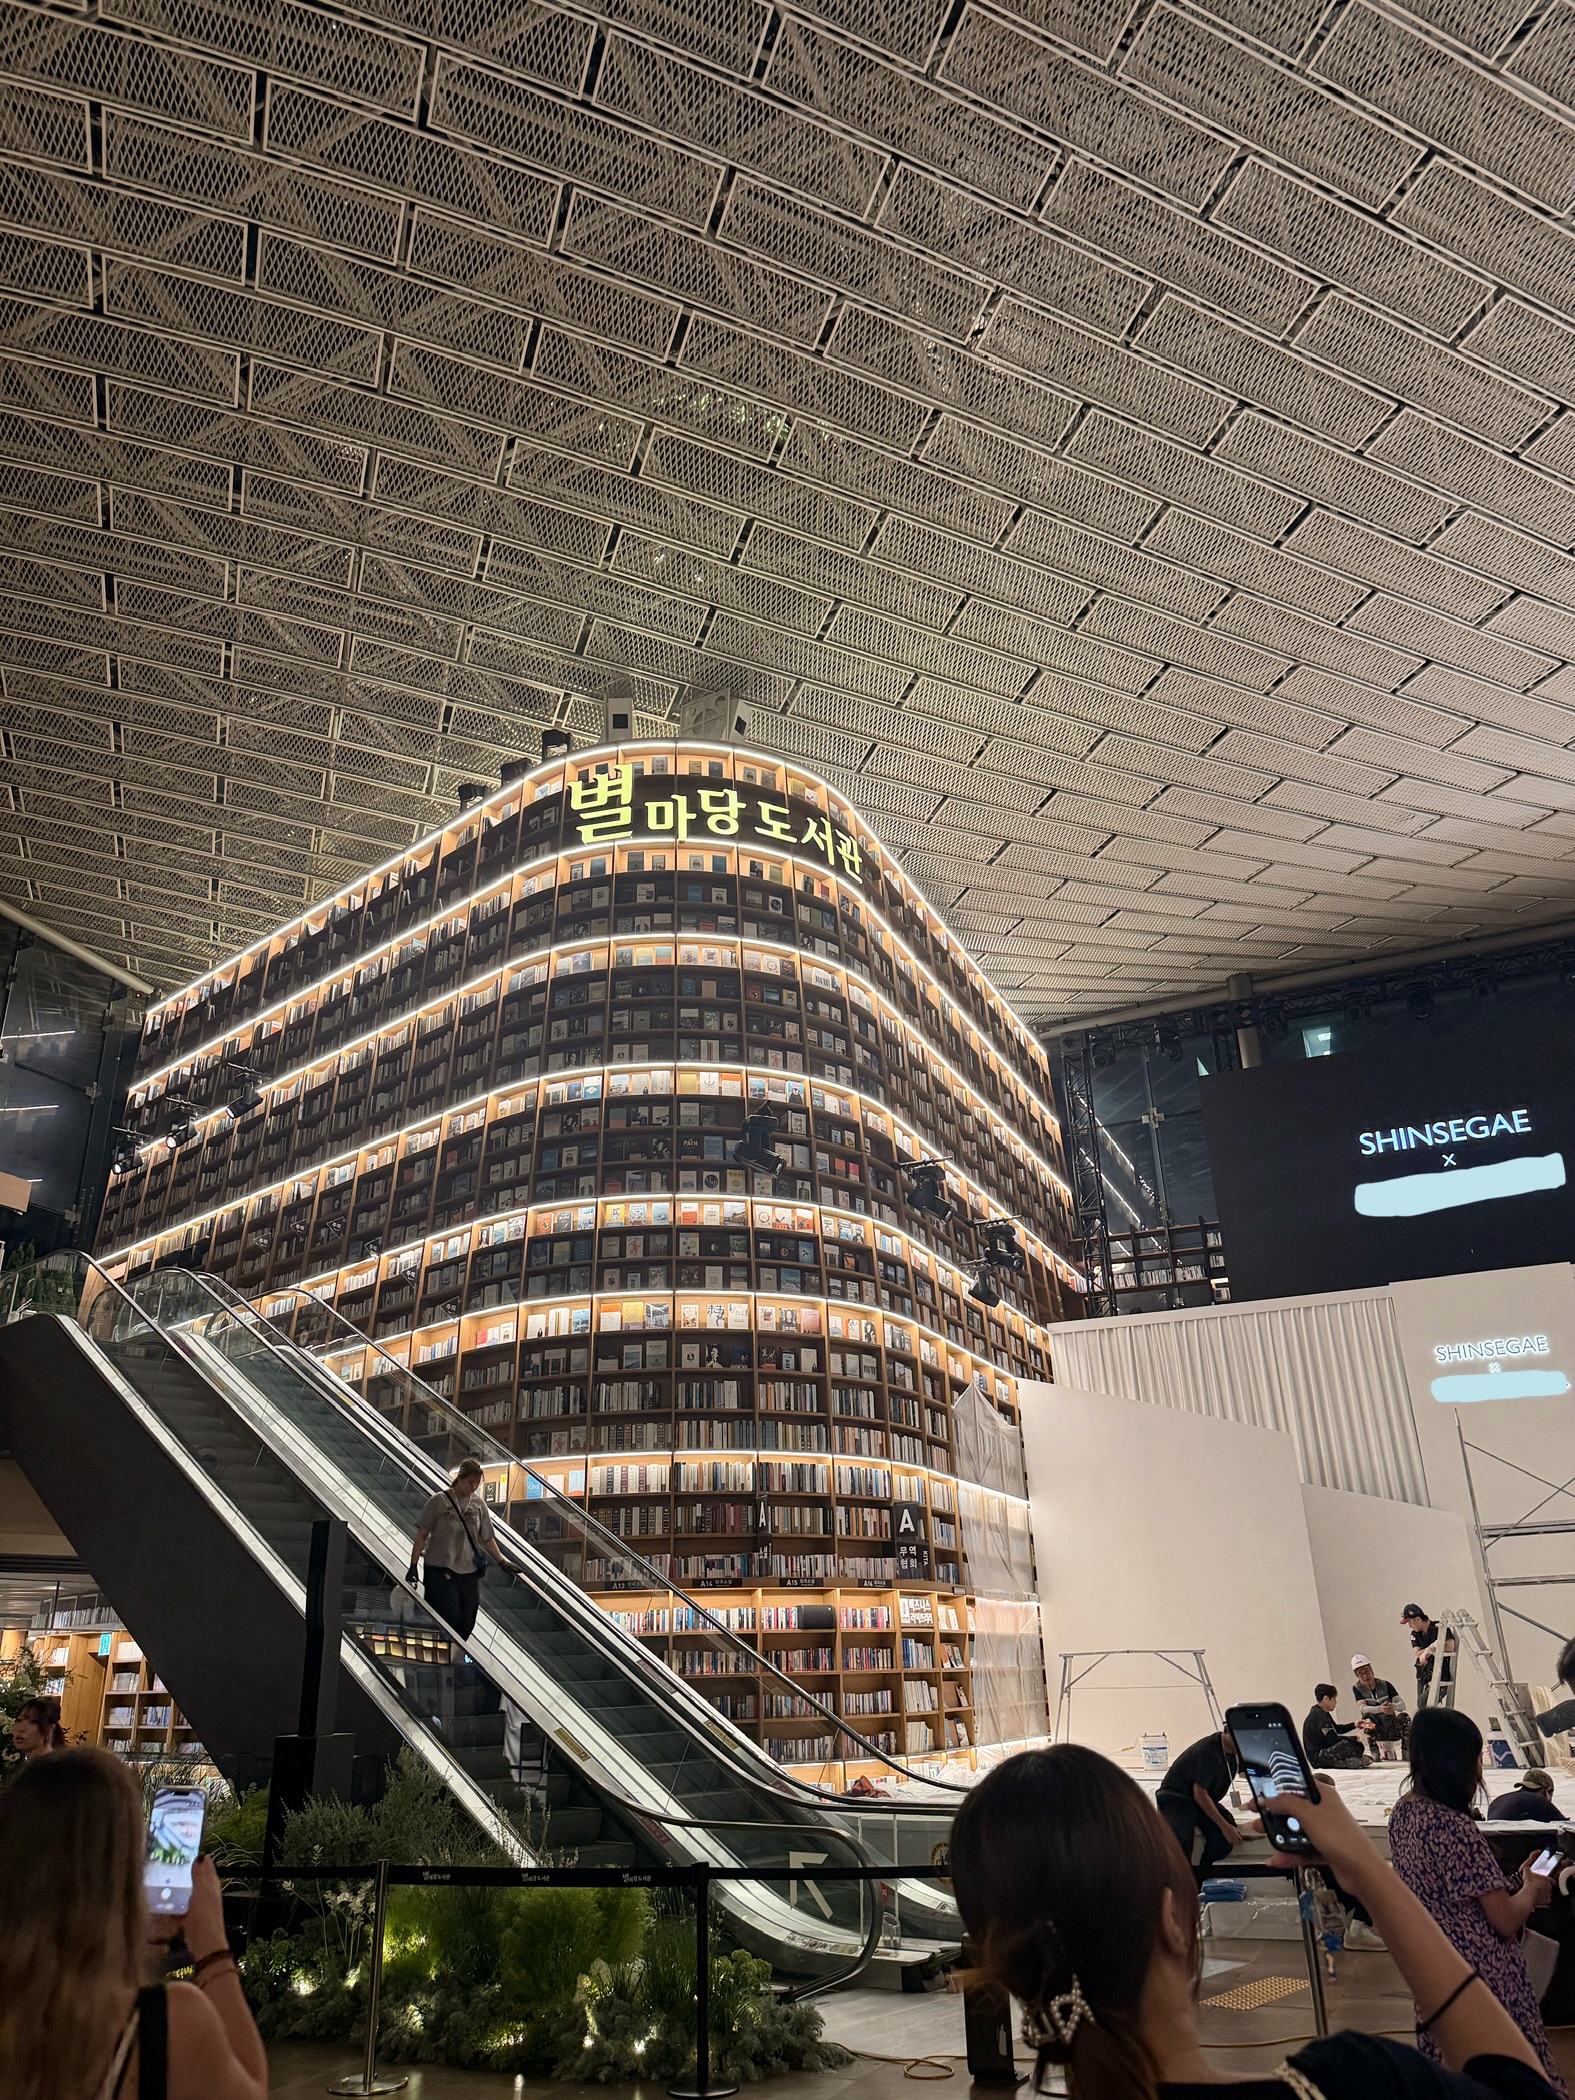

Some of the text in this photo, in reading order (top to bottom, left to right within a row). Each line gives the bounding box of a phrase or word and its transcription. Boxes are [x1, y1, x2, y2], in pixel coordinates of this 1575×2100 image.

[567, 763, 863, 884] 별마당 도서관
[1359, 1109, 1532, 1155] SHINSEGAE
[1436, 1336, 1548, 1362] SHINSEGAE
[759, 1502, 766, 1527] A
[899, 1508, 915, 1532] A
[612, 1582, 625, 1590] A13
[700, 1579, 713, 1587] A14
[786, 1578, 798, 1586] A15
[863, 1579, 873, 1587] A16
[909, 1598, 931, 1611] 비즈니스
[910, 1613, 934, 1624] 라이브러리
